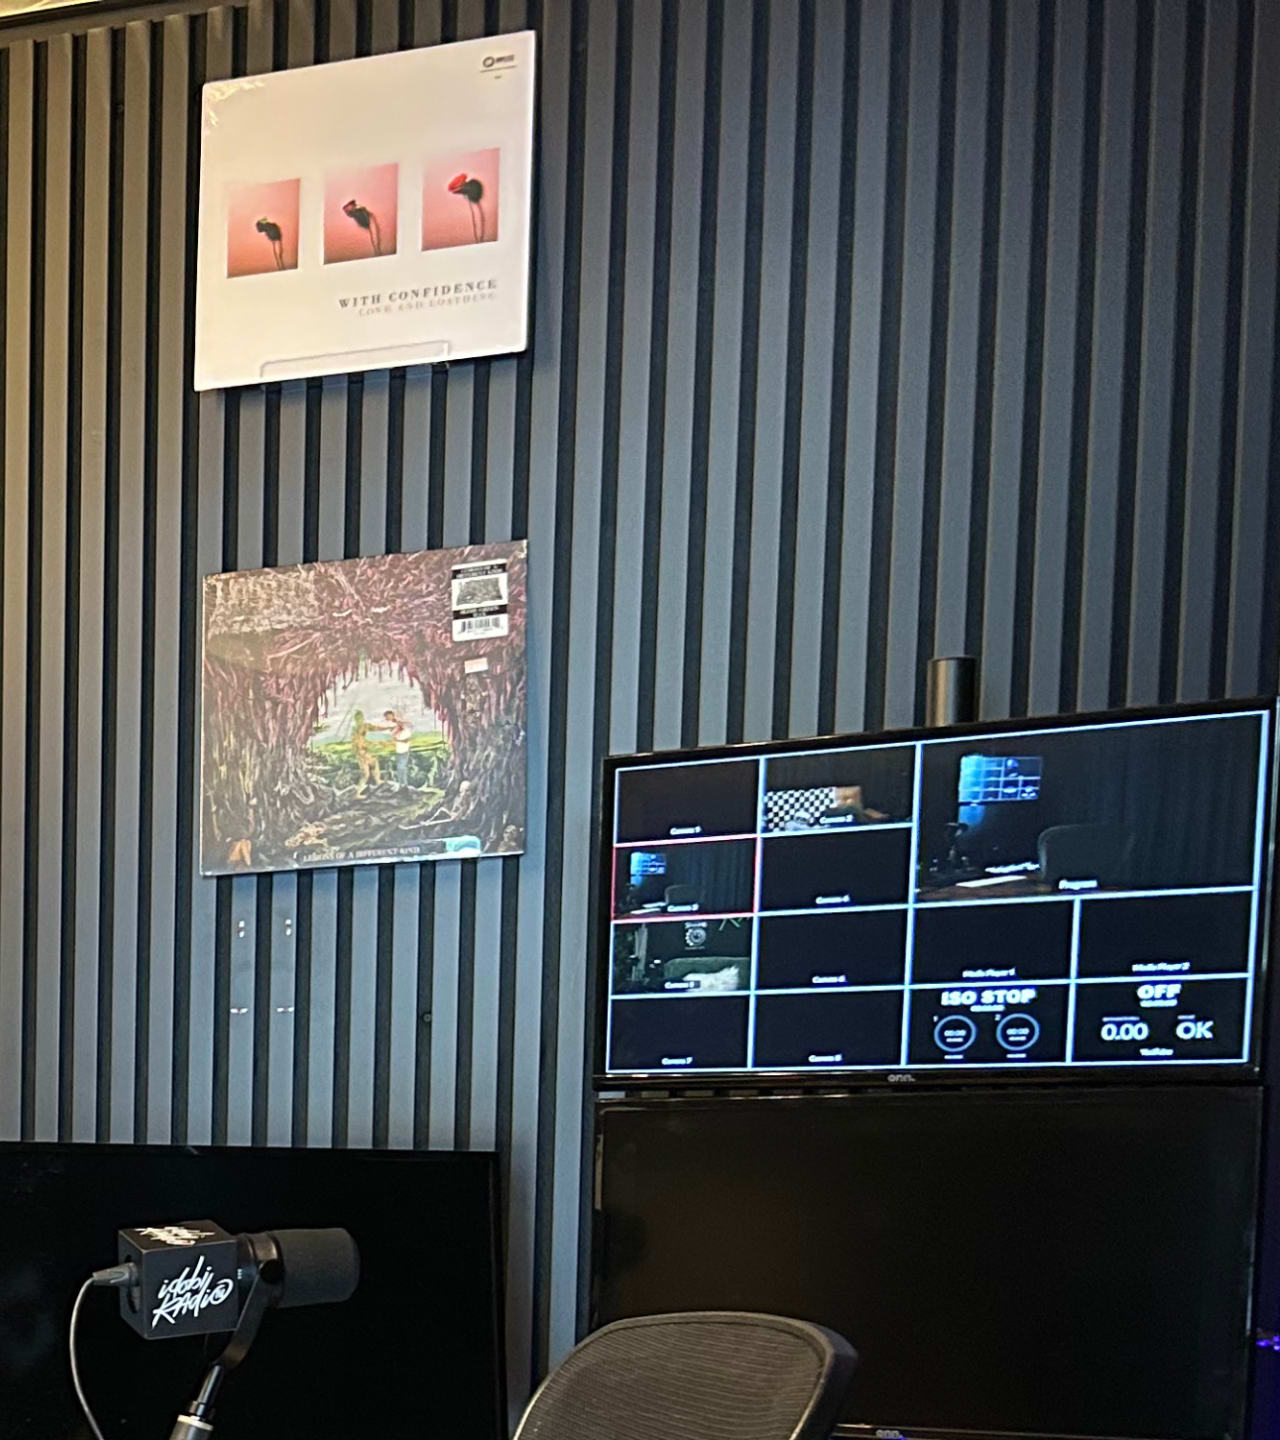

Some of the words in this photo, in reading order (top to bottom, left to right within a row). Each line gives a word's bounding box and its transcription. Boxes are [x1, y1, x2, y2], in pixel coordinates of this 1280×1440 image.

[339, 294, 381, 309] WITH
[389, 279, 498, 303] CONFIDENCE
[940, 990, 978, 1006] ISO
[980, 988, 1037, 1004] STOP
[1136, 984, 1182, 1000] OFF
[1101, 1022, 1149, 1041] 0.00
[1175, 1020, 1214, 1039] OK
